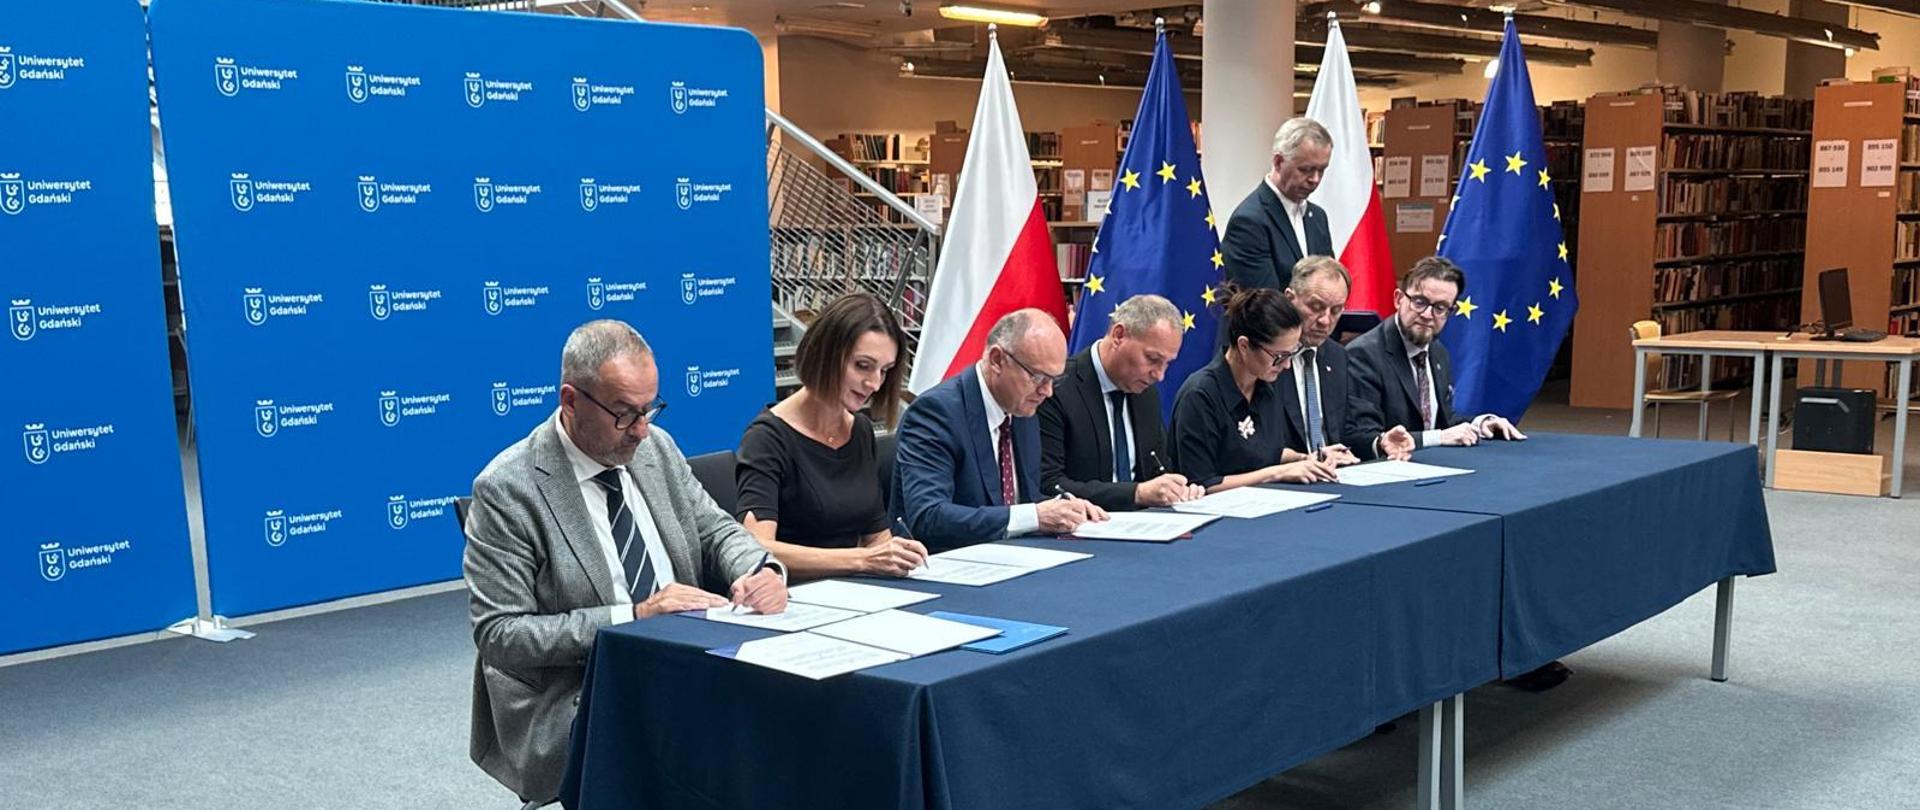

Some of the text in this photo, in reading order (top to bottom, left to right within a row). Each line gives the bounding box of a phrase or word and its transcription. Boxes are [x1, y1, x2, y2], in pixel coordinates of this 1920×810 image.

[18, 55, 84, 69] Uniwersytet
[19, 69, 64, 79] Gdański
[240, 67, 298, 80] Uniwersytet
[242, 79, 281, 89] Gdański
[369, 75, 421, 87] Uniwersytet
[485, 81, 533, 92] Uniwersytet
[591, 85, 634, 96] Uniwersytet
[688, 89, 728, 98] Uniwersytet
[27, 180, 91, 192] Uniwersytet
[255, 181, 311, 193] Uniwersytet
[380, 183, 431, 194] Uniwersytet
[495, 185, 541, 195] Uniwersytet
[598, 185, 641, 194] Uniwersytet
[693, 184, 731, 193] Uniwersytet
[28, 193, 72, 204] Gdański
[256, 193, 294, 202] Gdański
[605, 282, 646, 292] Uniwersytet
[698, 277, 735, 287] Uniwersytet
[391, 290, 441, 301] Uniwersytet
[503, 287, 549, 296] Uniwersytet
[268, 294, 323, 305] Uniwersytet
[37, 304, 101, 316] Uniwersytet
[269, 306, 307, 316] Gdański
[39, 317, 82, 329] Gdański
[703, 368, 739, 378] Uniwersytet
[511, 385, 556, 395] Uniwersytet
[401, 394, 450, 405] Uniwersytet
[279, 403, 333, 415] Uniwersytet
[280, 415, 317, 427] Gdański
[51, 424, 114, 439] Uniwersytet
[53, 439, 96, 452] Gdański
[289, 510, 342, 524] Uniwersytet
[289, 524, 326, 535] Gdański
[67, 540, 130, 557] Uniwersytet
[69, 555, 112, 569] Gdański
